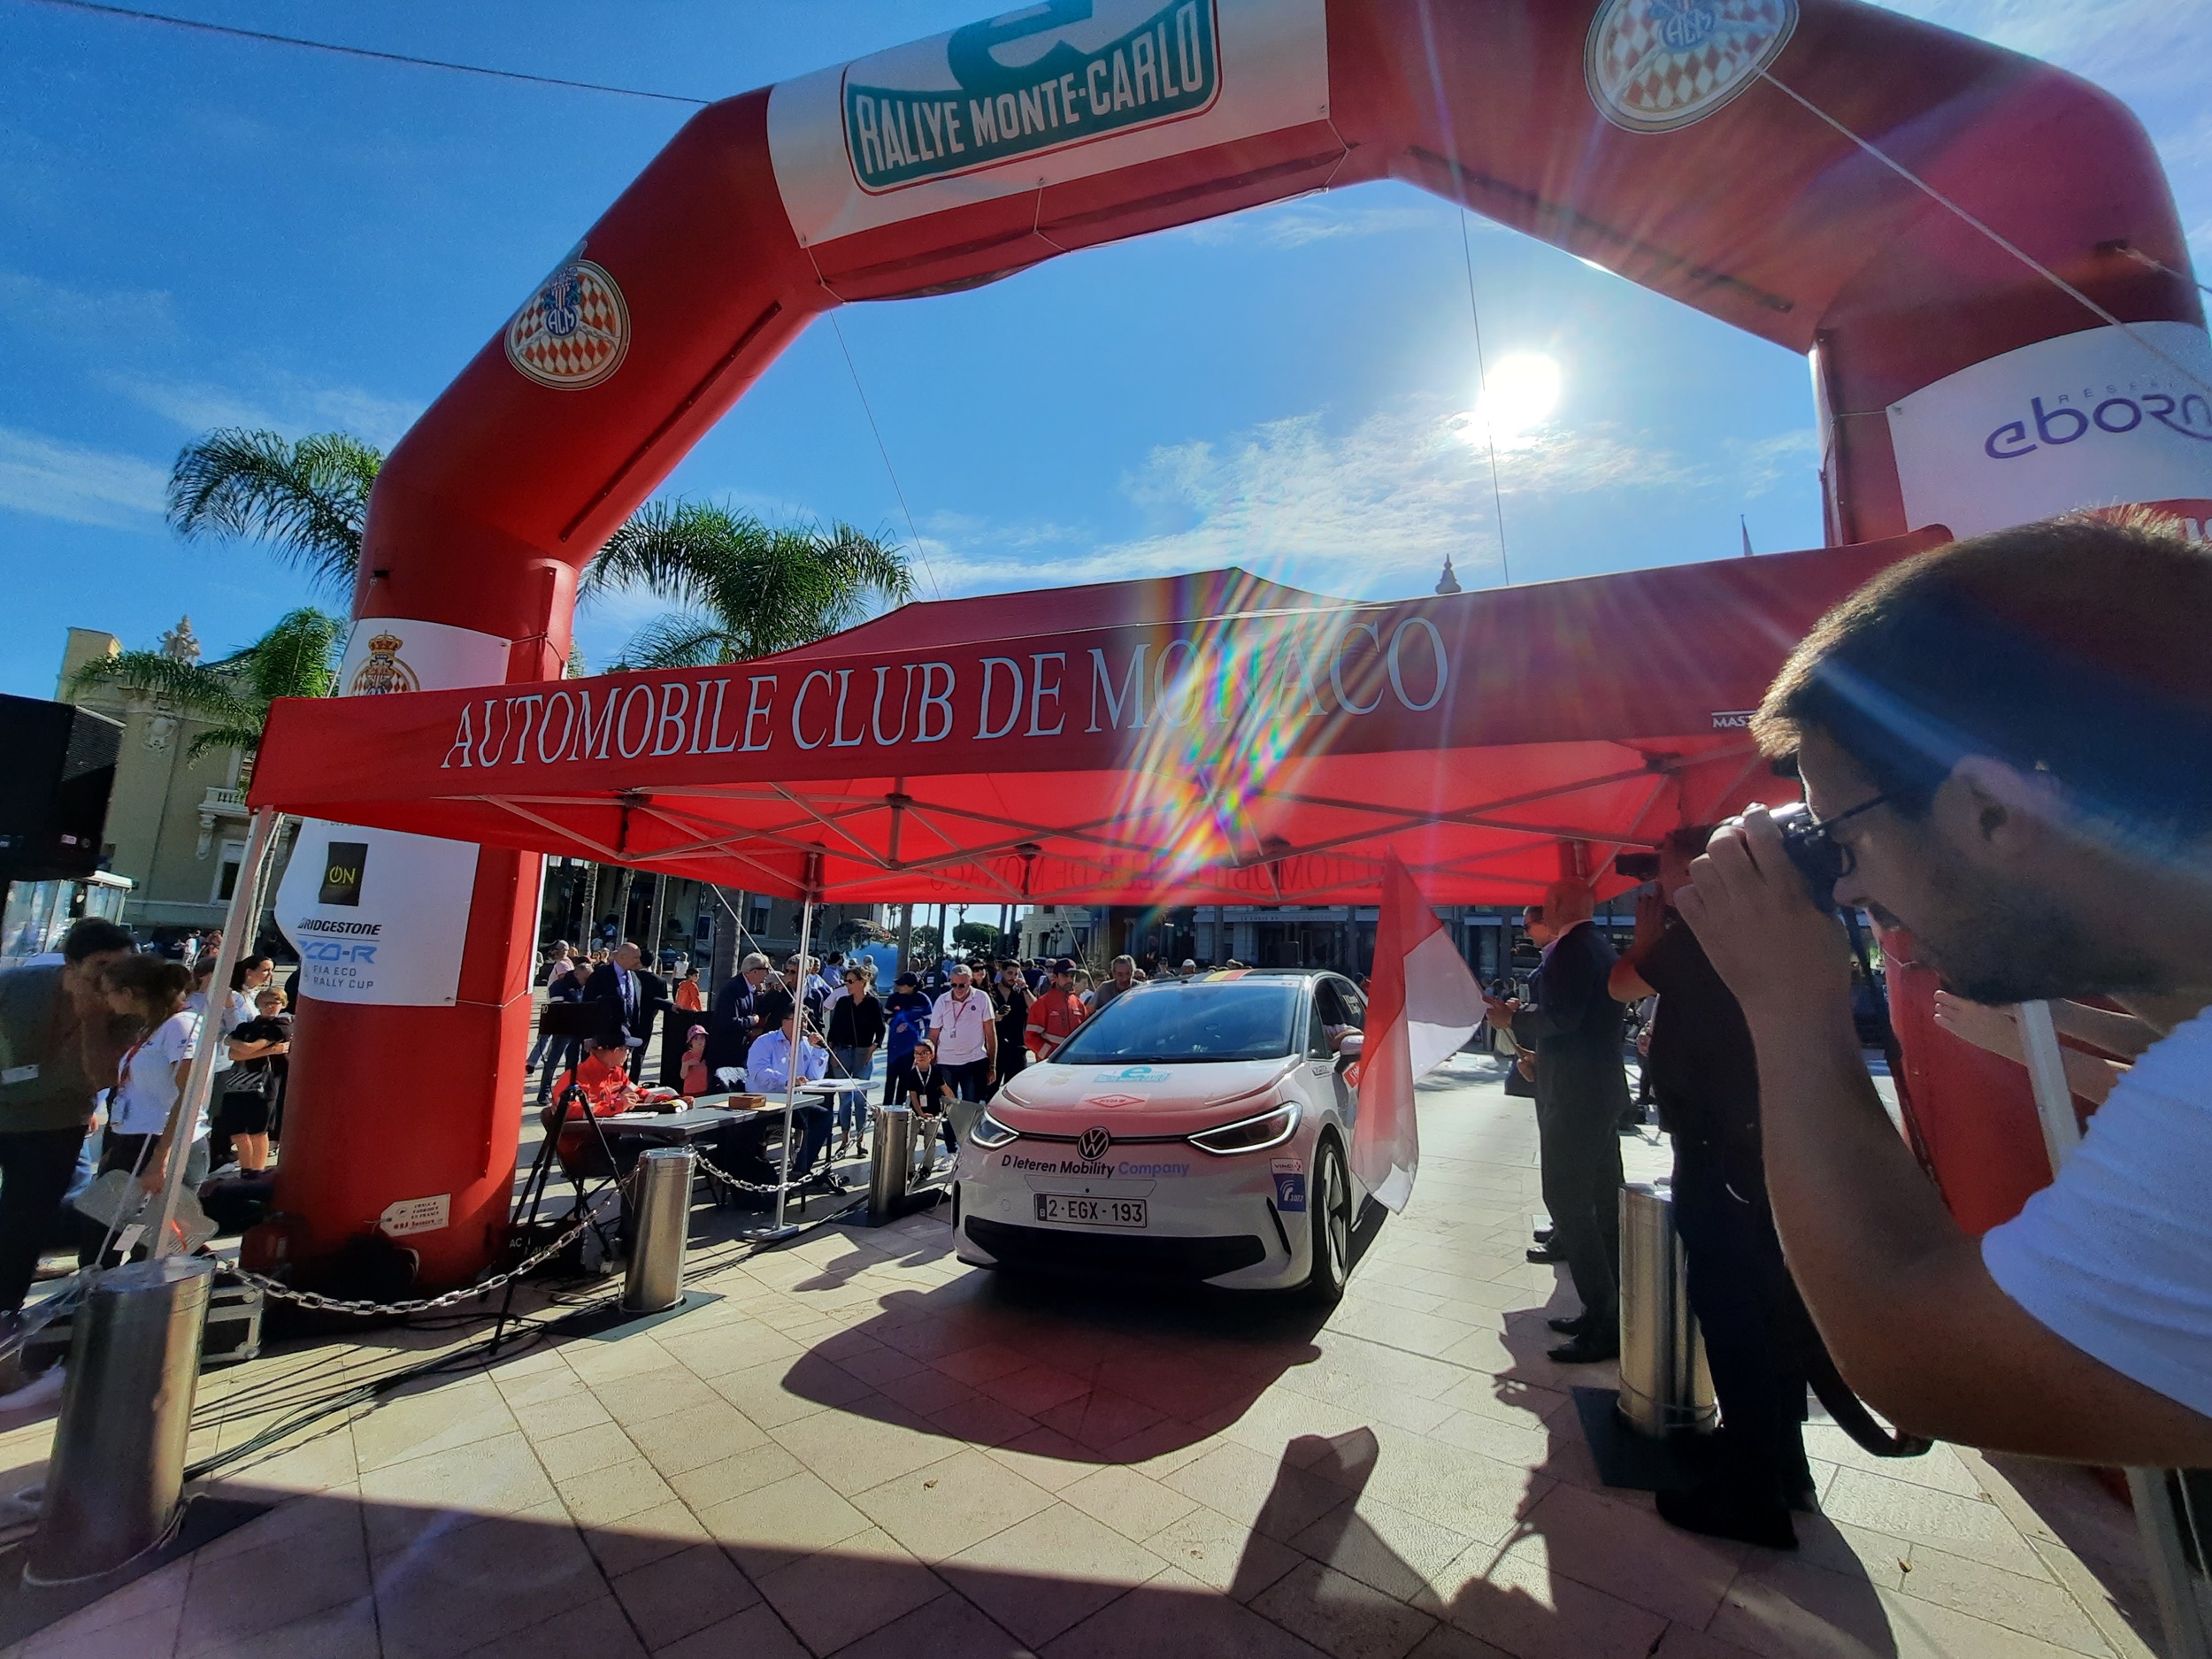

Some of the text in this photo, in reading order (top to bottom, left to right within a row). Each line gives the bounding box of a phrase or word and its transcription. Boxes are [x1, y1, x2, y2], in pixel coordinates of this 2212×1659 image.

[856, 3, 1203, 175] RALLYE MONTE-CARLO
[441, 616, 1448, 769] AUTOMOBILE CLUB DE MONACO
[1712, 715, 1749, 728] MAS
[329, 865, 357, 885] ON
[297, 918, 382, 935] BRIDGESTONE
[313, 964, 357, 977] FIA ECO
[313, 976, 374, 989] RALLY CUP
[1060, 1160, 1115, 1178] Mobility
[1118, 1161, 1190, 1178] Company
